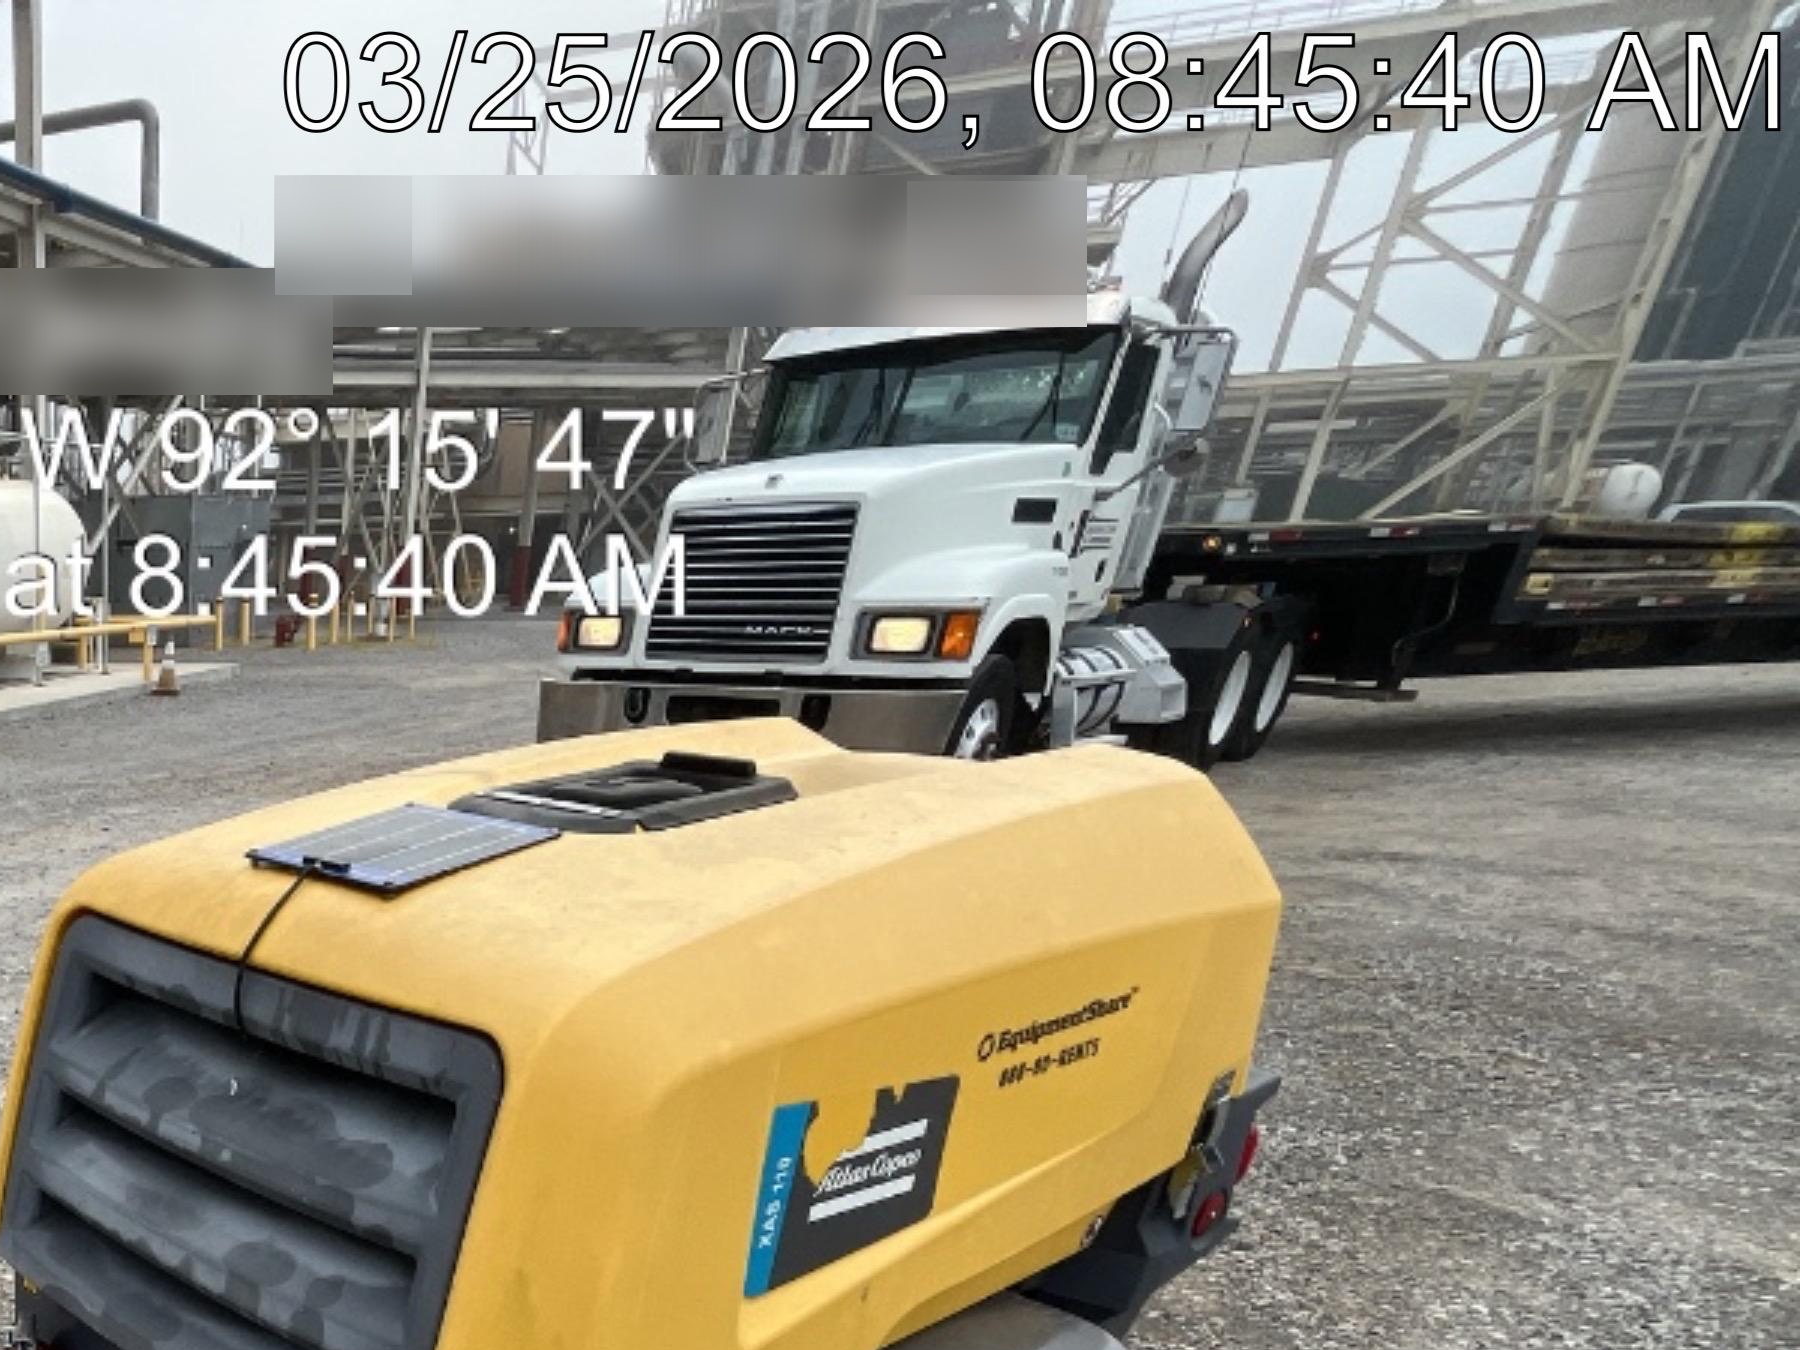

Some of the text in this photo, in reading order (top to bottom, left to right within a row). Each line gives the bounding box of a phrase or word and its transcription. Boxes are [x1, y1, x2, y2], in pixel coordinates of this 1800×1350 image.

[758, 1157, 793, 1249] XAS 110
[813, 1149, 923, 1198] Atlas Copco
